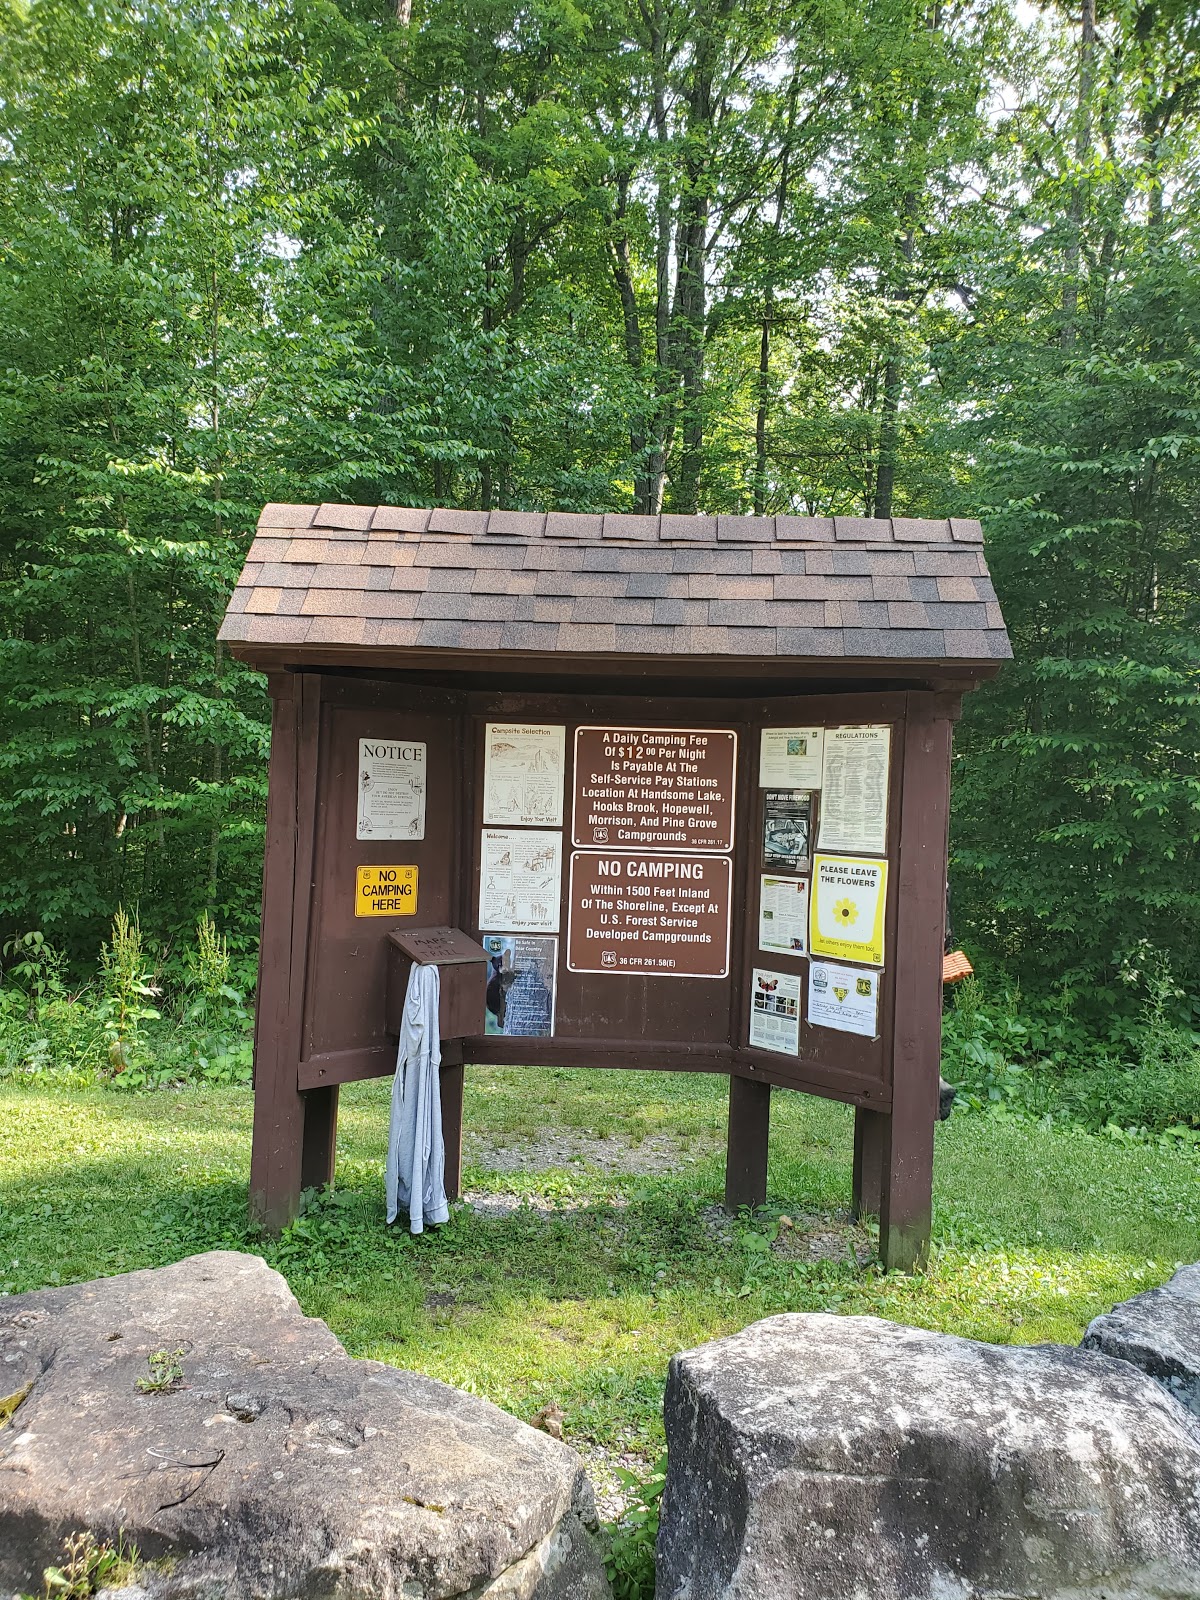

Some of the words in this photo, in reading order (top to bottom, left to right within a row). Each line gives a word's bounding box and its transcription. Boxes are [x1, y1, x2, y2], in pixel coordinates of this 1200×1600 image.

[492, 727, 520, 735] Campsite
[603, 733, 610, 743] A
[613, 734, 639, 746] Daily
[642, 734, 687, 746] Camping
[690, 736, 708, 746] Fee
[364, 745, 422, 762] NOTICE
[605, 747, 617, 757] Of
[659, 749, 676, 759] Per
[679, 749, 706, 761] Night
[611, 761, 620, 771] Is
[623, 761, 663, 772] Payable
[666, 763, 677, 772] At
[680, 763, 698, 772] The
[591, 774, 652, 785] Self-Service
[655, 776, 674, 788] Pay
[677, 776, 718, 787] Stations
[582, 788, 625, 798] Location
[628, 789, 639, 799] At
[641, 790, 694, 801] Handsome
[697, 791, 725, 803] Lake,
[593, 801, 624, 812] Hooks
[627, 802, 659, 815] Brook,
[662, 804, 713, 816] Hopewell,
[588, 815, 637, 827] Morrison,
[640, 817, 659, 827] And
[663, 817, 685, 828] Pine
[688, 818, 717, 829] Grove
[618, 829, 687, 842] Campgrounds
[379, 870, 397, 882] NO
[598, 860, 621, 876] NO
[627, 862, 704, 879] CAMPING
[820, 866, 849, 874] PLEASE
[851, 869, 878, 877] LEAVE
[837, 878, 876, 888] FLOWERS
[362, 884, 412, 897] CAMPING
[591, 885, 623, 895] Within
[626, 886, 651, 896] 1500
[654, 887, 676, 897] Feet
[679, 888, 710, 899] Inland
[372, 899, 401, 910] HERE
[581, 899, 593, 909] Of
[596, 900, 613, 910] The
[617, 900, 669, 913] Shoreline,
[672, 903, 705, 915] Except
[708, 904, 719, 914] At
[600, 914, 622, 924] U.S.
[626, 916, 657, 926] Forest
[660, 917, 698, 928] Service
[586, 929, 639, 942] Developed
[642, 931, 712, 943] Campgrounds
[644, 958, 676, 968] 261.58(E)
